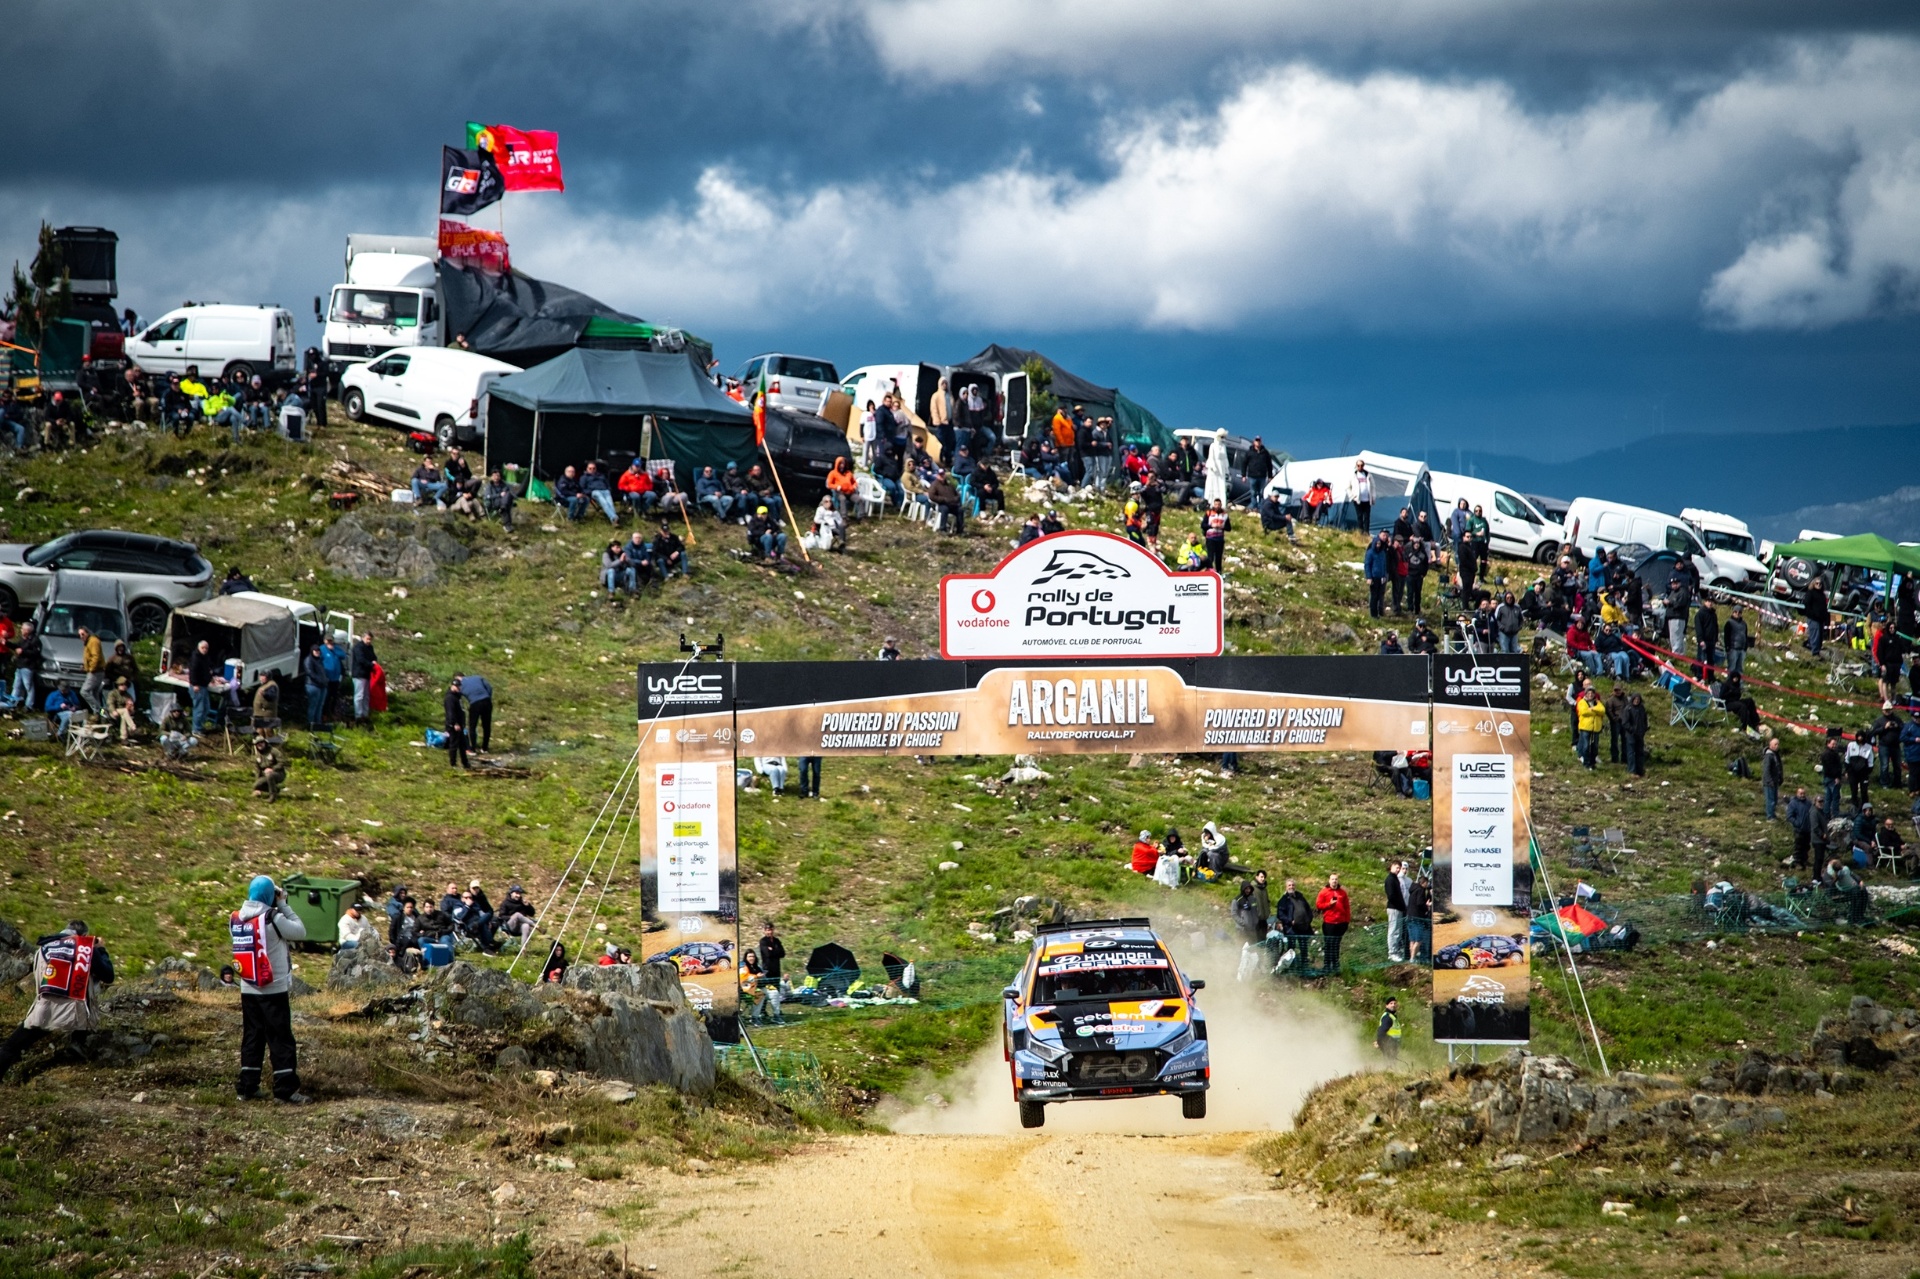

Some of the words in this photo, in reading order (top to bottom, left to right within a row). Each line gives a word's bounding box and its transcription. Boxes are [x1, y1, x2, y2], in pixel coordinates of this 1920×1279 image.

[1028, 589, 1080, 606] rally
[1085, 589, 1113, 602] de
[956, 616, 1010, 628] vodafone
[1025, 605, 1181, 630] Portugal
[1445, 666, 1521, 683] WRC
[648, 675, 722, 692] WRC
[1446, 686, 1460, 695] FIA
[649, 695, 662, 704] FIA
[1008, 678, 1154, 725] ARGANIL
[821, 712, 883, 732] POWERED
[884, 712, 902, 731] BY
[903, 711, 959, 731] PASSION
[1204, 708, 1266, 728] POWERED
[1267, 708, 1286, 727] BY
[1286, 708, 1343, 727] PASSION
[1475, 720, 1493, 733] 40
[713, 728, 731, 740] 40
[821, 734, 888, 747] SUSTAINABLE
[889, 733, 905, 747] BY
[905, 733, 942, 747] CHOICE
[1027, 730, 1136, 739] RALLYDEPORTUGAL.PT
[1204, 730, 1272, 744] SUSTAINABLE
[1272, 730, 1288, 743] BY
[1288, 729, 1326, 743] CHOICE
[1460, 762, 1505, 772] WRC
[679, 918, 701, 931] FIA
[1472, 912, 1495, 926] FIA
[75, 945, 92, 972] 228
[1084, 952, 1152, 961] HYUNDAI
[1458, 995, 1504, 1004] Portugal
[1073, 1012, 1145, 1025] cetelem
[1080, 1055, 1148, 1079] i20
[1173, 1071, 1197, 1080] HYUNDAI
